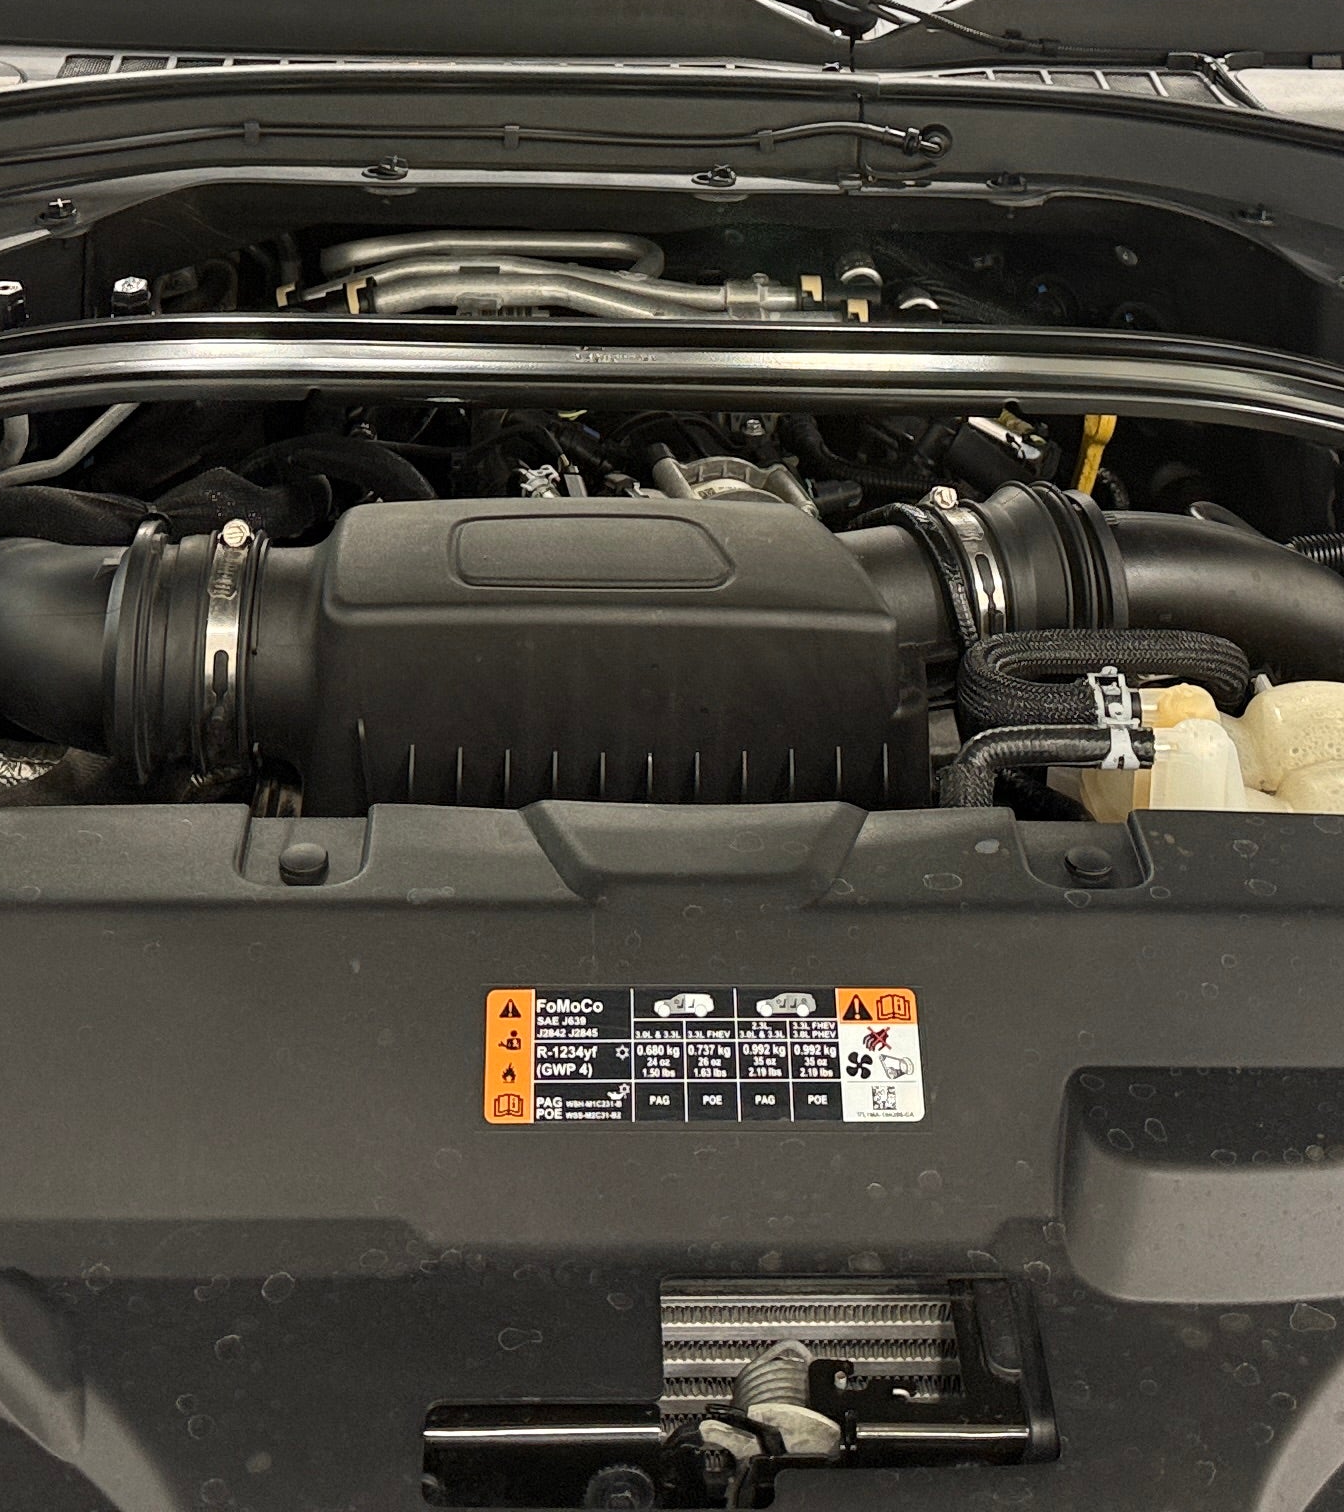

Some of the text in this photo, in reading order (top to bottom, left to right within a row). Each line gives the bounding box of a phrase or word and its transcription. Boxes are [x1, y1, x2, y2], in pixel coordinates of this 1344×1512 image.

[536, 998, 604, 1014] FoMoCo
[536, 1016, 587, 1026] SAE J639
[536, 1028, 567, 1038] J2842
[536, 1045, 598, 1061] R-1234yf
[636, 1044, 681, 1059] 0.680 kg
[687, 1044, 732, 1059] 0.737 kg
[742, 1043, 786, 1058] 0.992 kg
[793, 1044, 837, 1058] 0.992 kg
[646, 1056, 671, 1067] 24 oz
[697, 1056, 722, 1067] 26 oz
[753, 1056, 777, 1066] 35 oz
[804, 1056, 828, 1067] 35 oz
[536, 1063, 593, 1078] (GWP 4)
[642, 1067, 676, 1078] 1.50 lbs
[712, 1067, 727, 1078] lbs
[767, 1067, 783, 1077] lbs
[819, 1067, 834, 1077] lbs
[536, 1097, 563, 1108] PAG
[649, 1095, 671, 1106] PAG
[702, 1094, 723, 1105] POE
[755, 1095, 776, 1105] PAG
[807, 1094, 828, 1105] POE
[536, 1108, 563, 1120] POE
